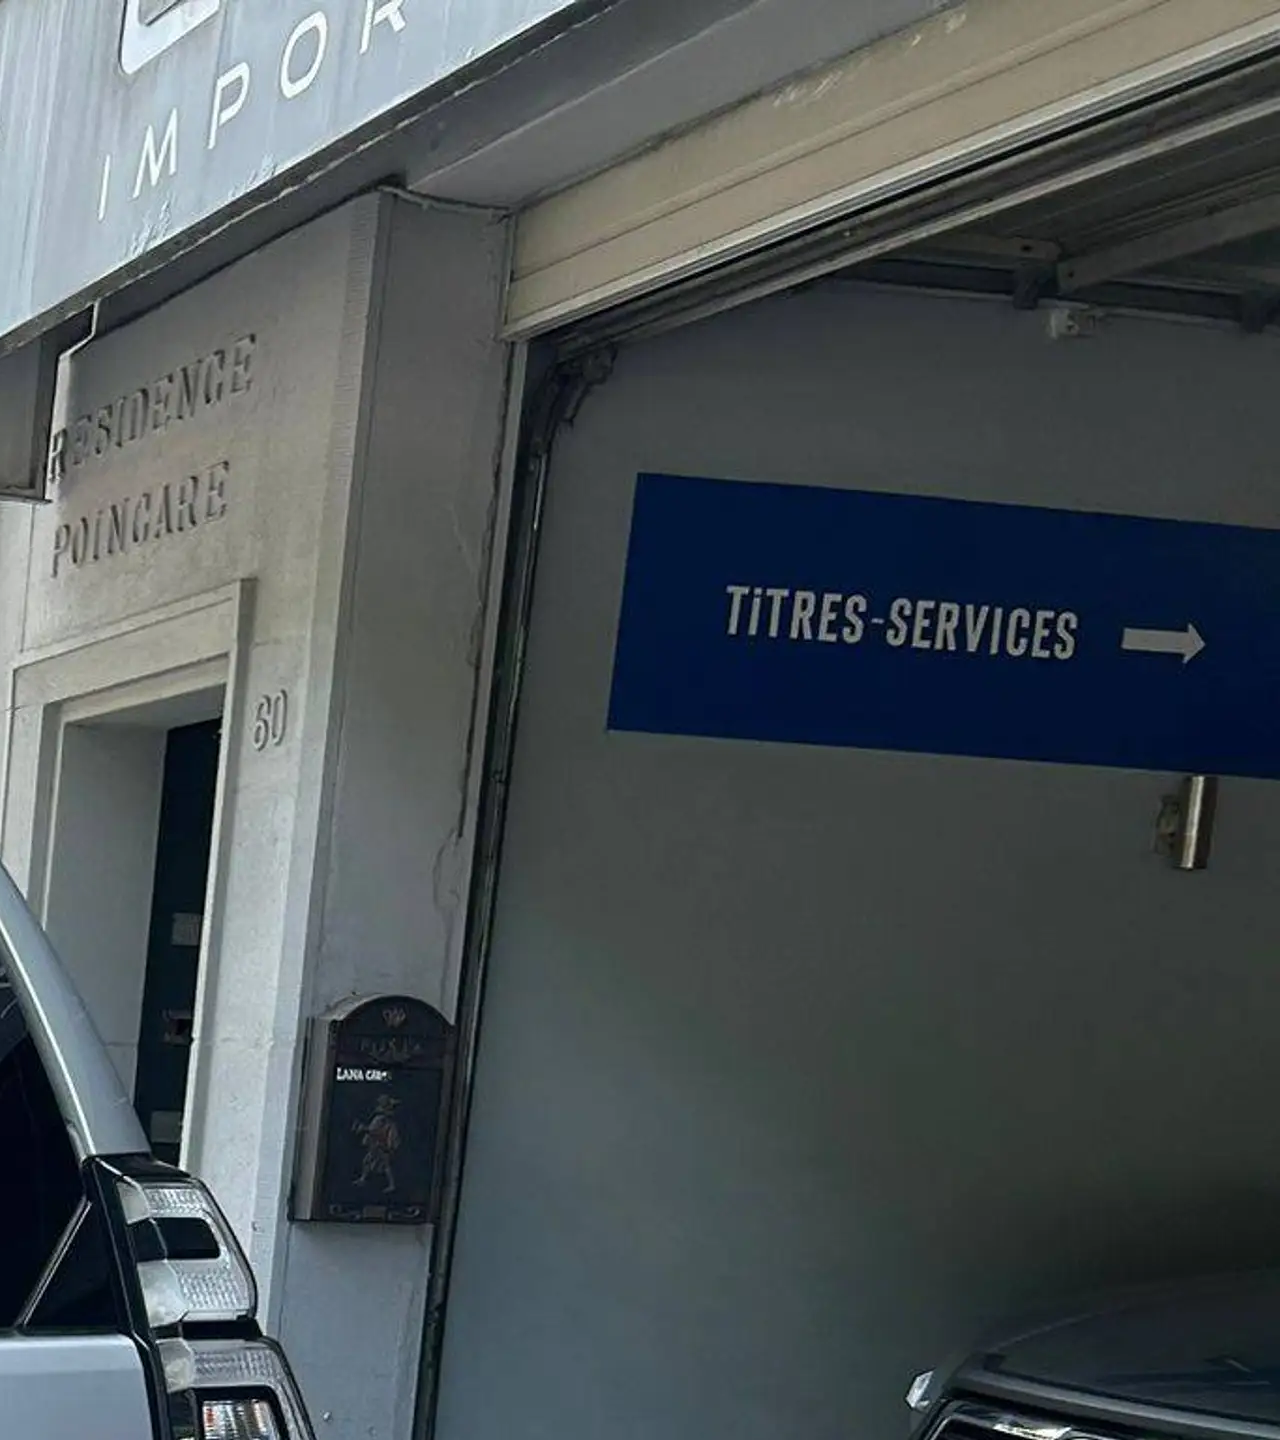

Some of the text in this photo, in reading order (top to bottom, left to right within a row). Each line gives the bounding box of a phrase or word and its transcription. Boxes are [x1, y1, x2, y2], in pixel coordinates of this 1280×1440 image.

[50, 459, 231, 579] POINCARE
[252, 688, 288, 752] 60
[336, 1066, 364, 1081] LANA
